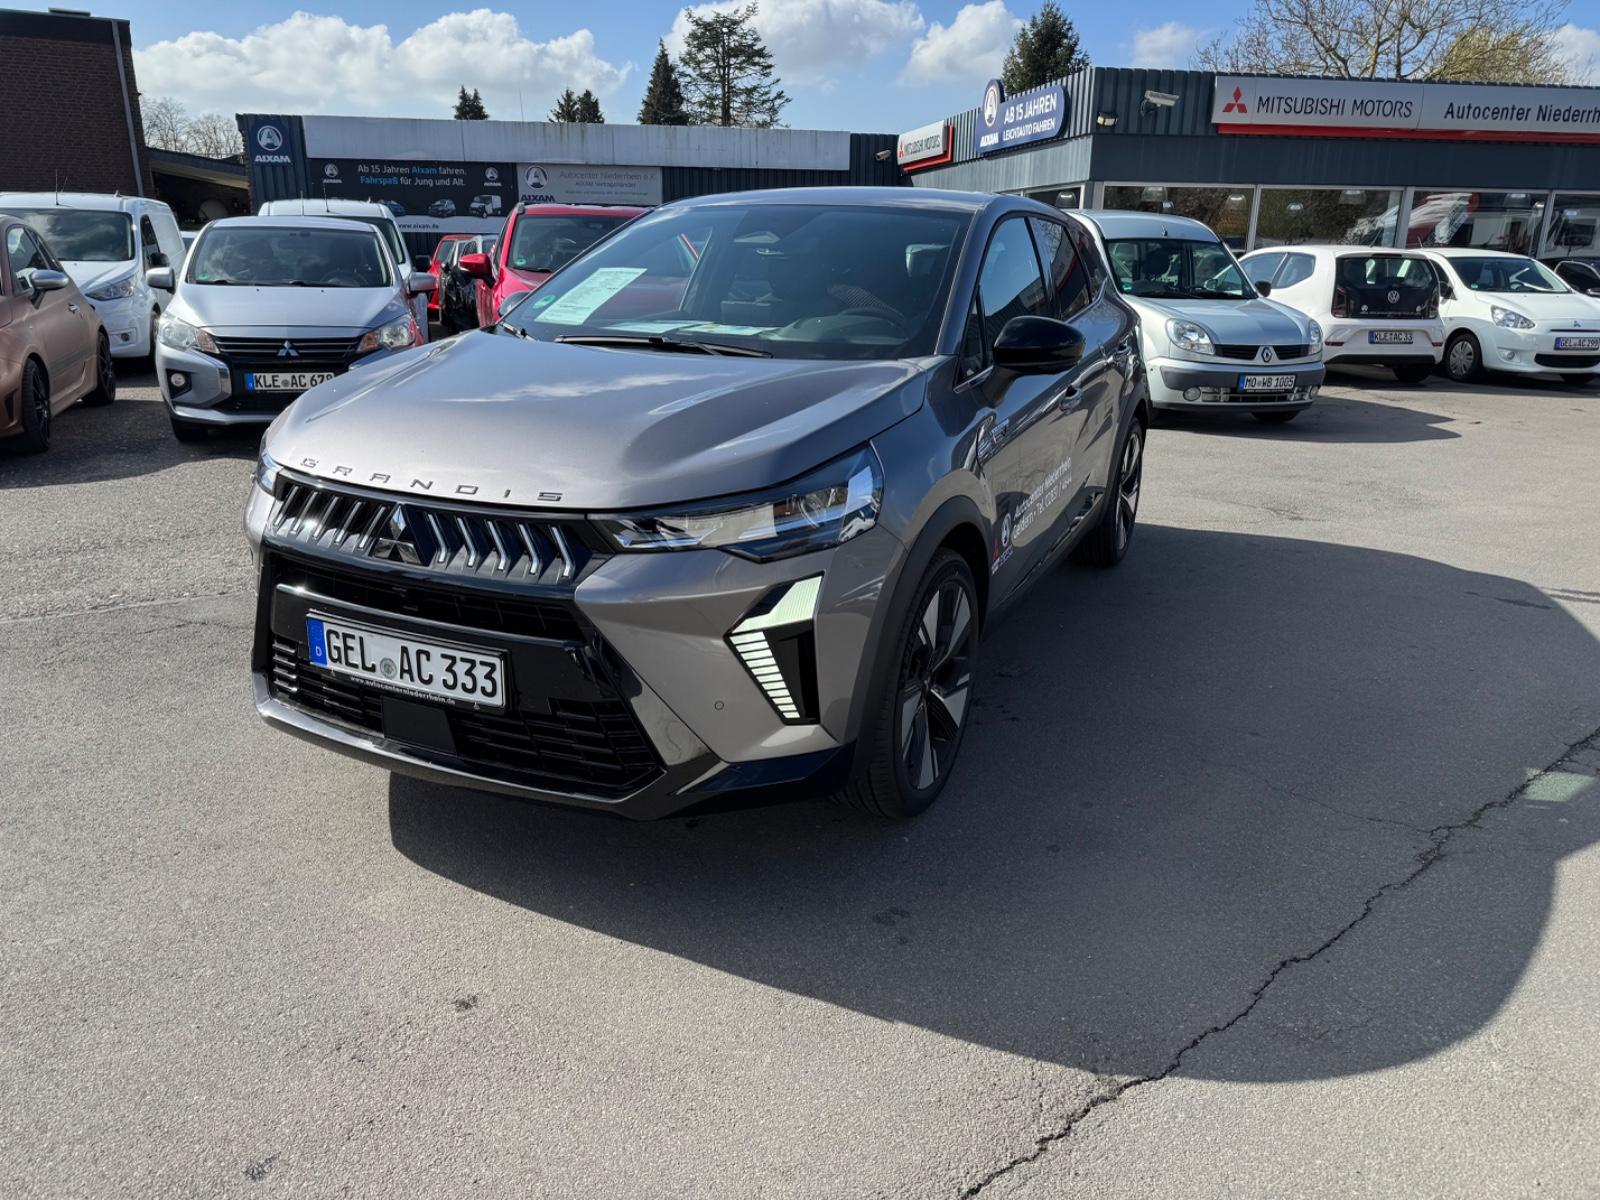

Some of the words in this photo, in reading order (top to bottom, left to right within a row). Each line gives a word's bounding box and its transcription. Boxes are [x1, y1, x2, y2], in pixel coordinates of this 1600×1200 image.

[1004, 107, 1014, 124] AB
[1015, 104, 1024, 121] 15
[1024, 93, 1057, 119] JAHREN
[1256, 96, 1346, 116] MITSUBISHI
[1351, 99, 1414, 118] MOTORS
[1444, 102, 1532, 121] Autocenter
[1003, 122, 1032, 141] LEICHTAUTO
[1032, 118, 1056, 136] FAHREN
[254, 154, 291, 164] AIXAM
[357, 165, 370, 174] Ab
[371, 165, 380, 174] 15
[382, 165, 410, 174] Jahren
[412, 166, 437, 175] Aixam
[439, 167, 467, 175] fahren.
[360, 176, 398, 186] Fahrspaß
[400, 176, 412, 185] für
[414, 178, 434, 187] Jung
[436, 178, 450, 186] und
[452, 178, 466, 186] Alt.
[520, 194, 556, 203] AIXAM
[255, 374, 280, 388] KLE
[290, 374, 307, 388] AC
[1245, 377, 1257, 388] MO
[300, 457, 563, 501] GRANDIS
[315, 646, 322, 657] D
[325, 629, 377, 673] GEL
[400, 645, 434, 686] AC
[440, 653, 498, 698] 333
